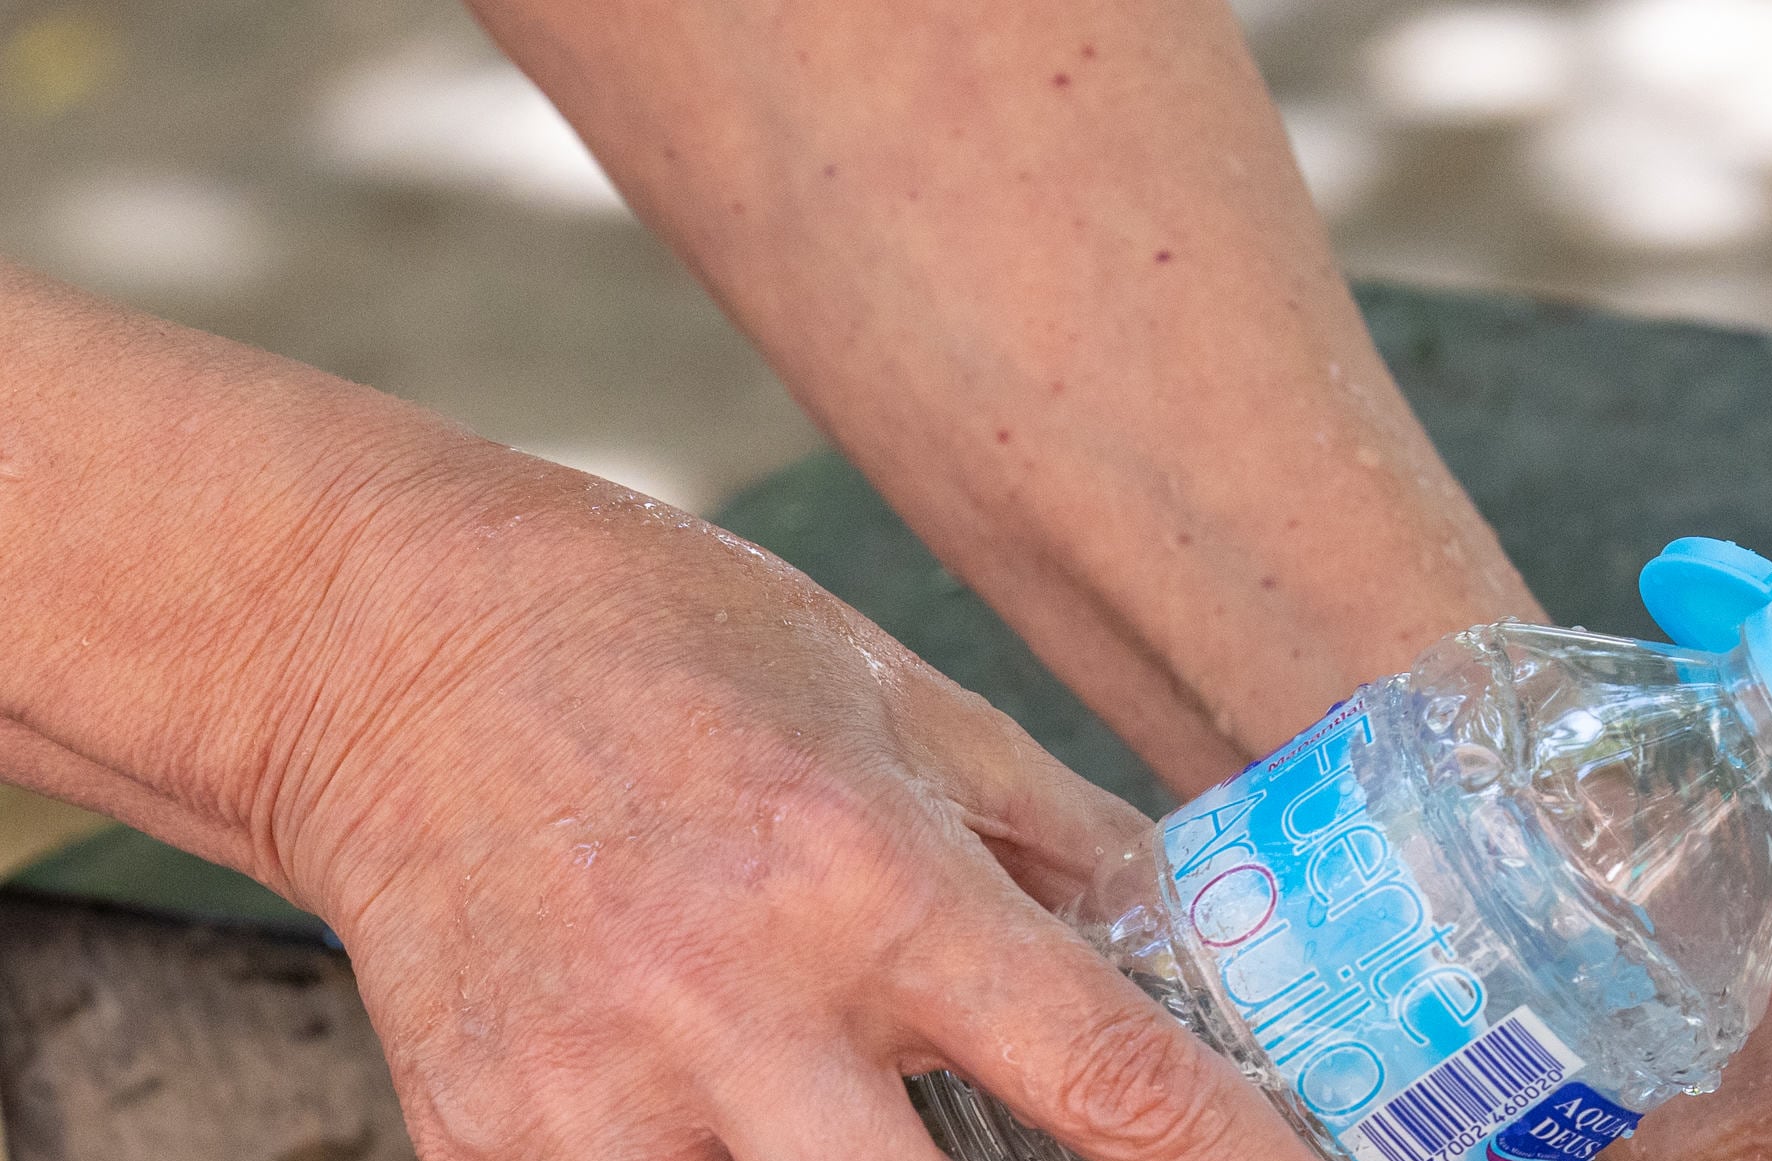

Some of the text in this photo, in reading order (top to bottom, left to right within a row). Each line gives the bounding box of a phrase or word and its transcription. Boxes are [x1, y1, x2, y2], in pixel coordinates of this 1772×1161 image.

[1267, 700, 1366, 773] Manantial
[1268, 711, 1488, 1047] Fuente
[1491, 1069, 1563, 1125] 460020
[1553, 1096, 1630, 1139] AQUA
[1528, 1116, 1602, 1159] DEUS
